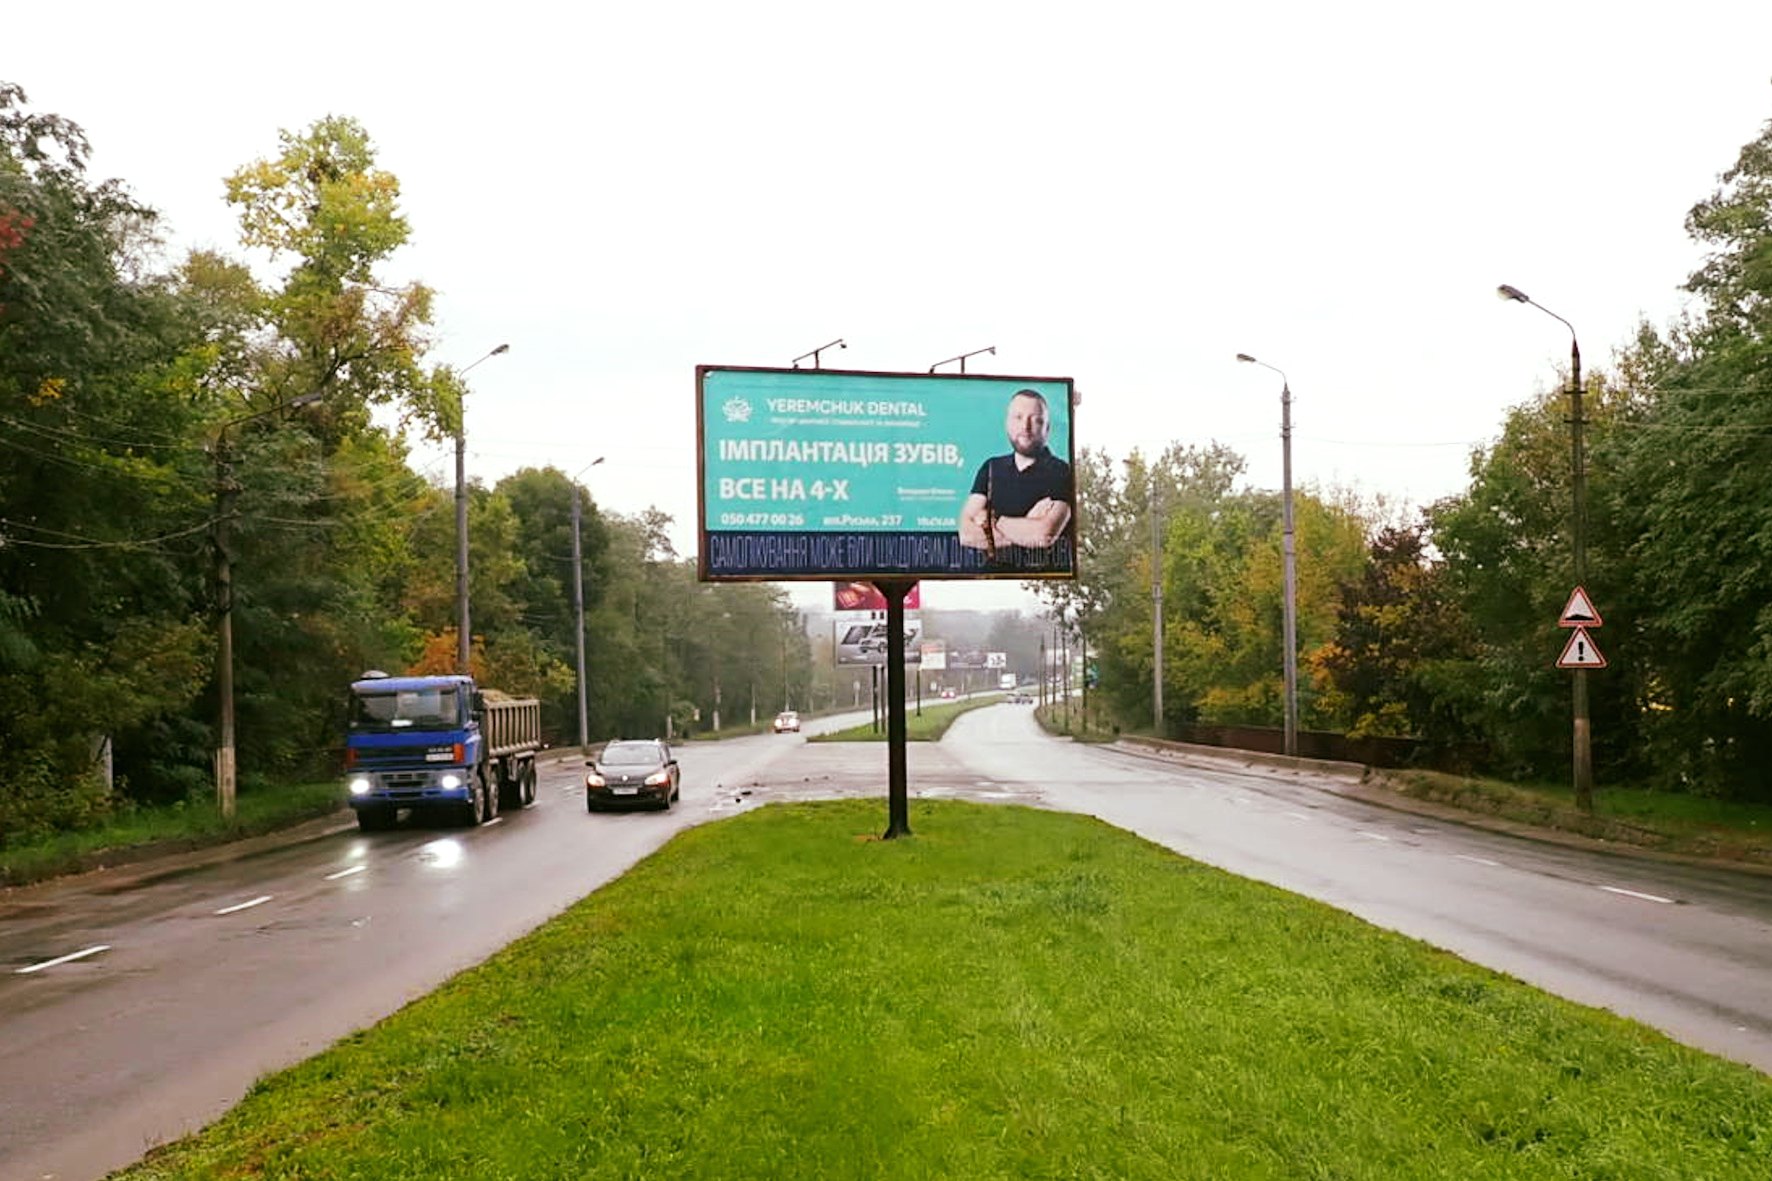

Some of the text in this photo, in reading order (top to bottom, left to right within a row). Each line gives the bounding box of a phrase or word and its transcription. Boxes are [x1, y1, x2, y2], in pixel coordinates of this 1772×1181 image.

[766, 398, 926, 416] YEREMCHUK DENTAL
[719, 439, 964, 467] ІМПЛАНТАЦІЯ ЗУБІВ,
[719, 478, 766, 500] ВСЕ
[770, 479, 806, 500] НА
[811, 536, 845, 568] МОЖЕ
